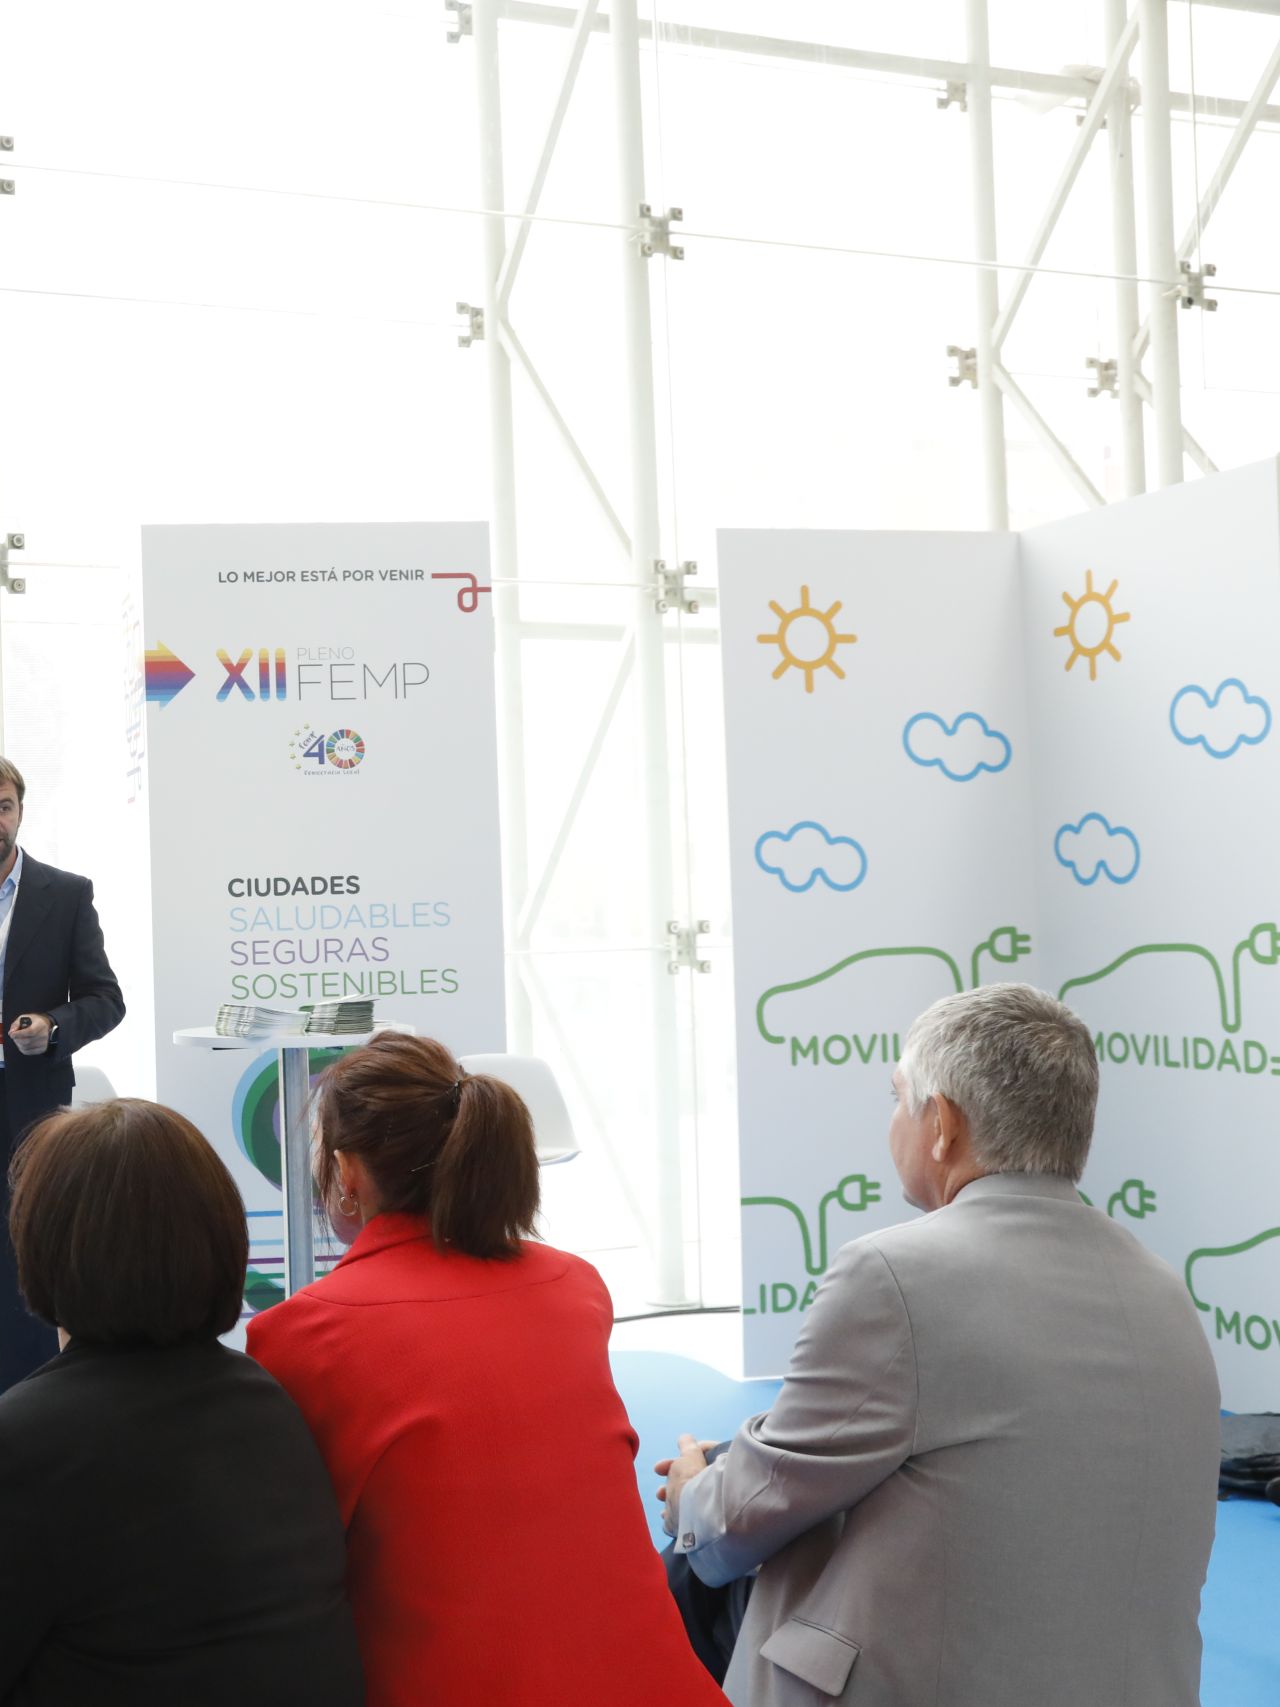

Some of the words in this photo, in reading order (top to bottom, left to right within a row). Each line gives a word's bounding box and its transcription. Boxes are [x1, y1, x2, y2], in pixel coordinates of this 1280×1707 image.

[218, 571, 239, 584] LO
[243, 570, 296, 583] MEJOR
[300, 566, 338, 582] ESTÁ
[342, 569, 374, 582] POR
[378, 568, 425, 581] VENIR
[297, 646, 355, 661] PLENO
[216, 647, 287, 702] XII
[297, 662, 430, 701] FEMP
[227, 875, 361, 898] CIUDADES
[229, 901, 451, 933] SALUDABLES
[230, 936, 390, 966] SEGURAS
[231, 968, 460, 1001] SOSTENIBLES
